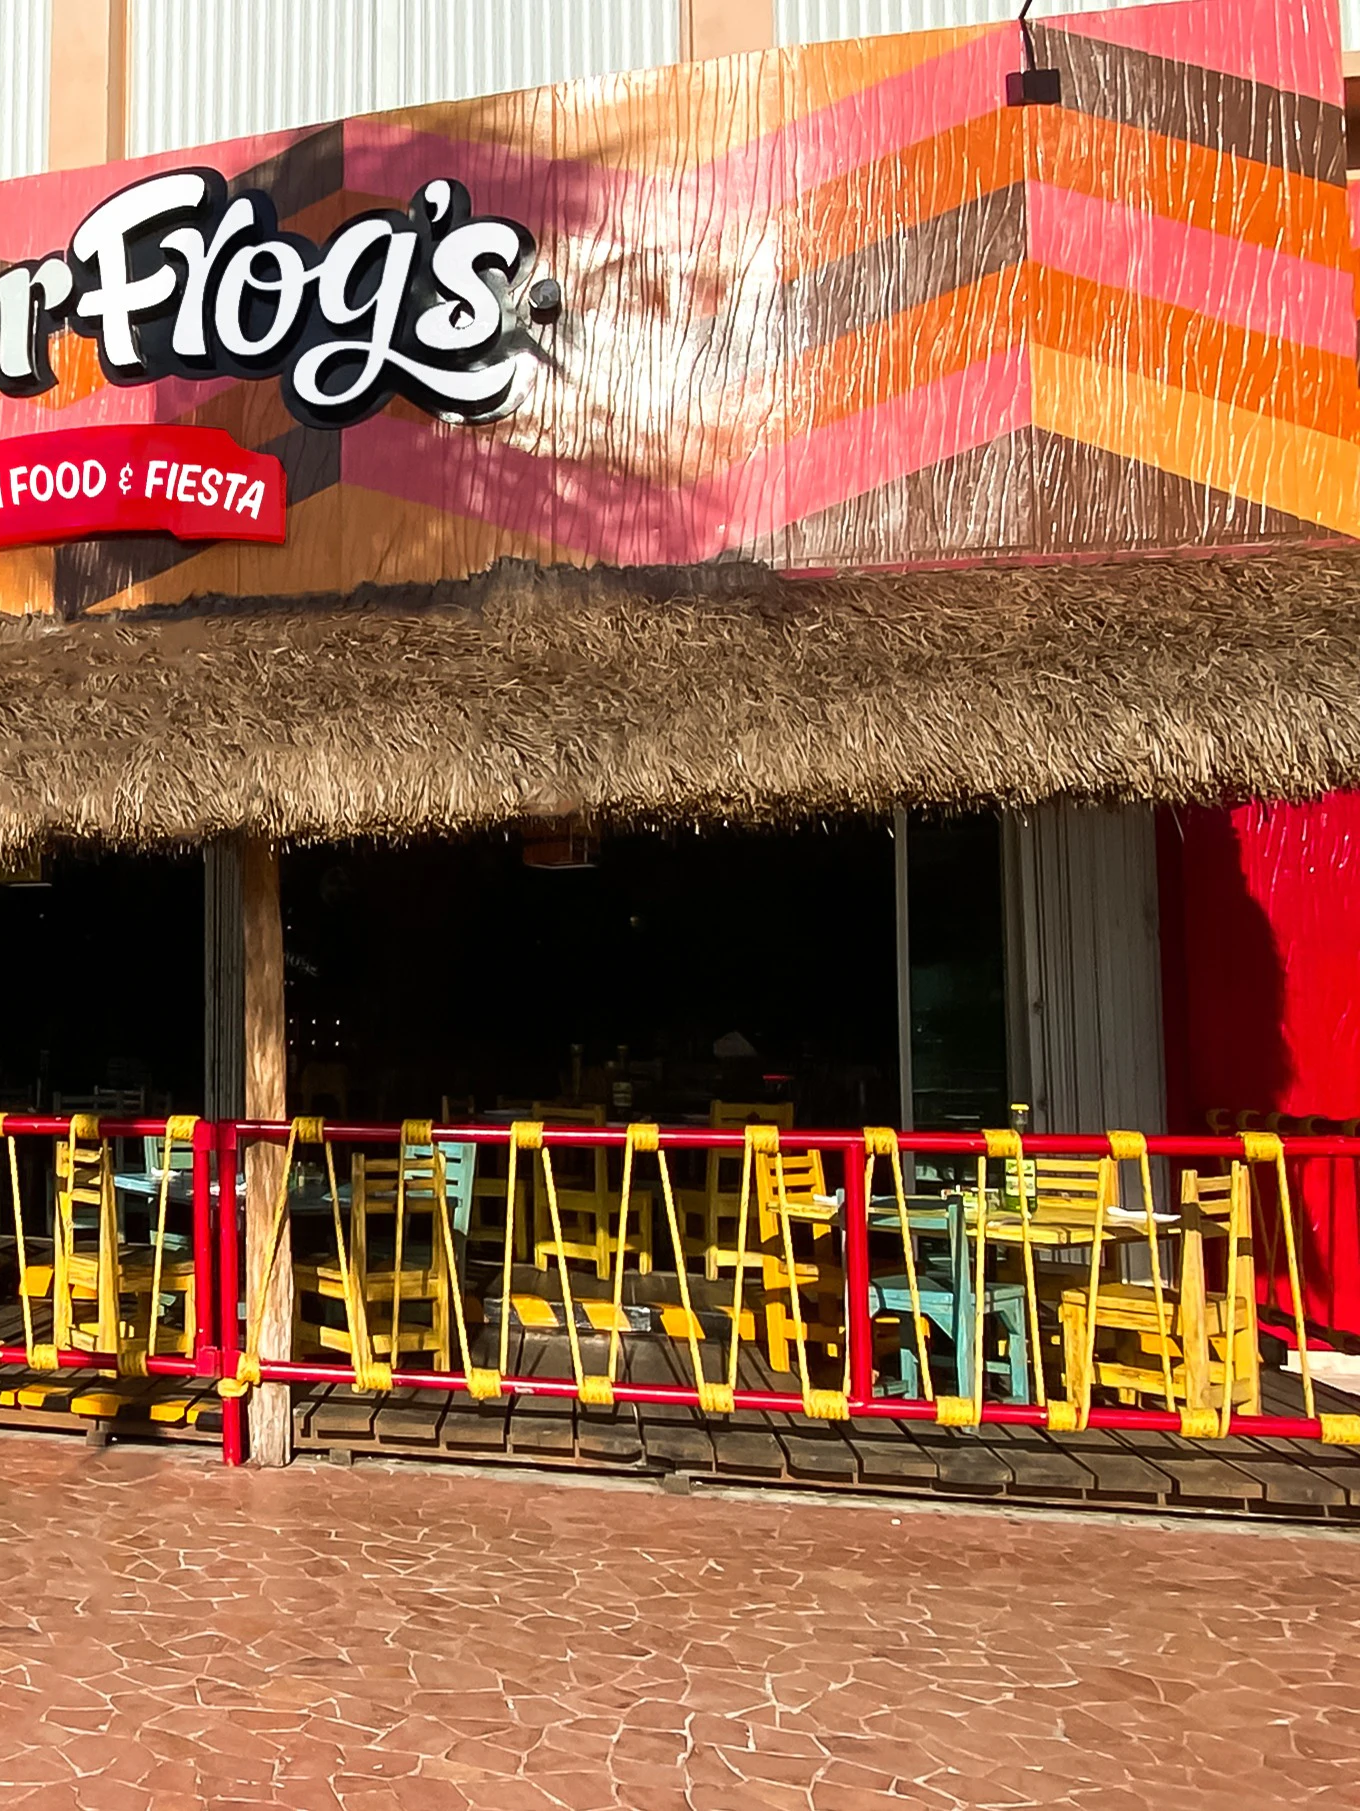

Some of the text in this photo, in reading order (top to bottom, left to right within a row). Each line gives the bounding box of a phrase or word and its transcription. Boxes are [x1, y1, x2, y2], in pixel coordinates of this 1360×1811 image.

[72, 170, 522, 408] Frog's
[9, 458, 108, 506] FOOD
[117, 462, 133, 495] &
[145, 459, 266, 520] FIESTA
